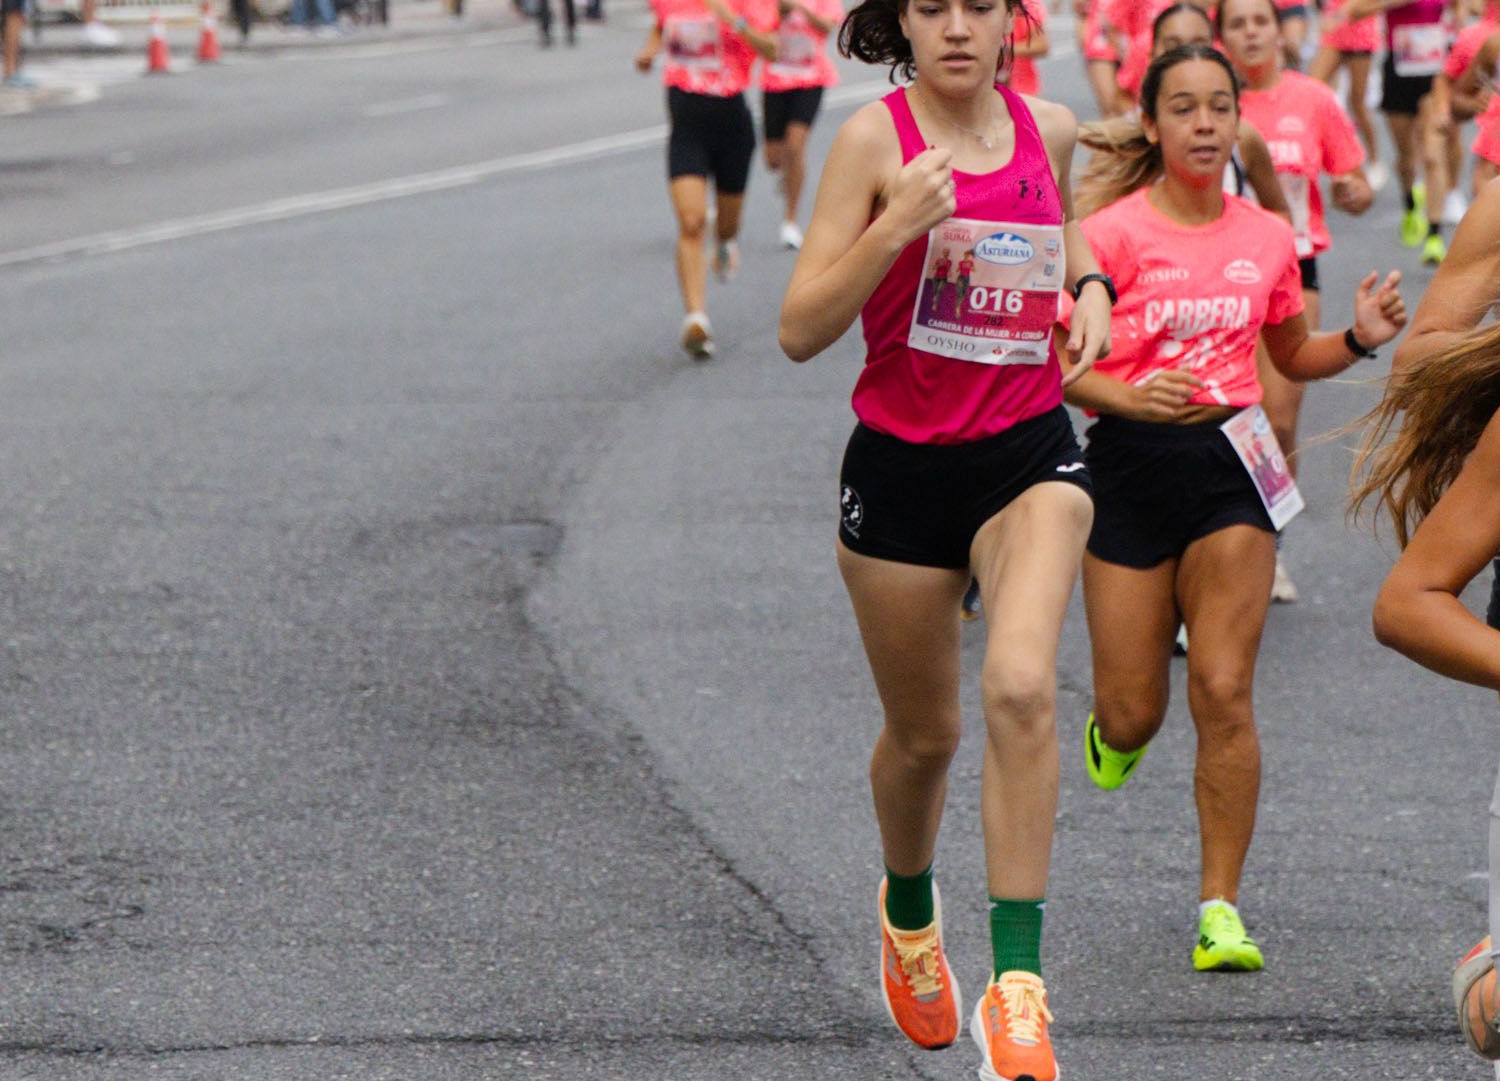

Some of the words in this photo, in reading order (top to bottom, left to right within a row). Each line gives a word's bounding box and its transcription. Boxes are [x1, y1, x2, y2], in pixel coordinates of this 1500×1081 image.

[978, 243, 1031, 259] ASTURIANA
[969, 287, 1023, 313] 016
[1144, 296, 1250, 334] CARRERA
[928, 319, 961, 332] CARRERA
[963, 326, 973, 334] DE
[974, 327, 984, 336] LA
[985, 328, 1010, 338] MUJER
[927, 334, 975, 353] OYSHO
